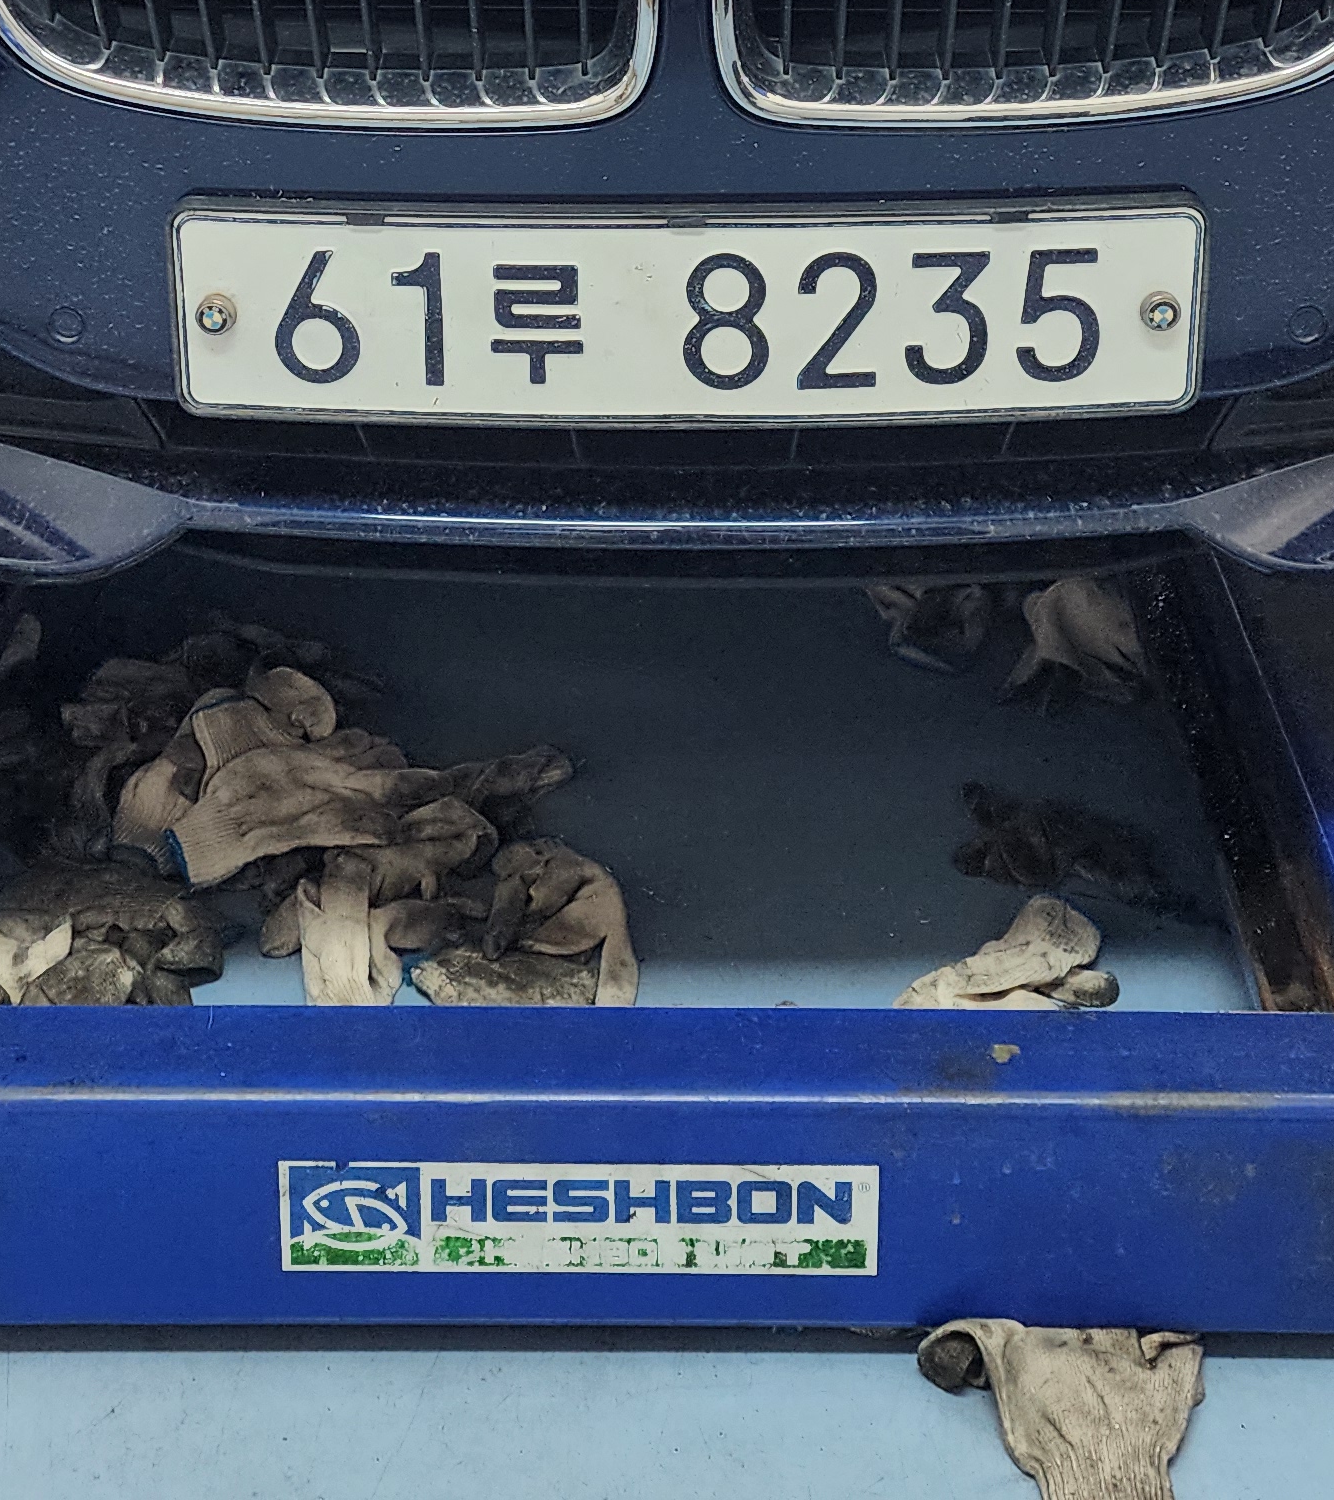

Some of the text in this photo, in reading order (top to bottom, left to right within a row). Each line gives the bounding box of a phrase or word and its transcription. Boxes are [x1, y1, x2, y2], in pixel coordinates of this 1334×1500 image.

[274, 247, 1101, 391] 61루 8235
[430, 1177, 854, 1226] HESHBON
